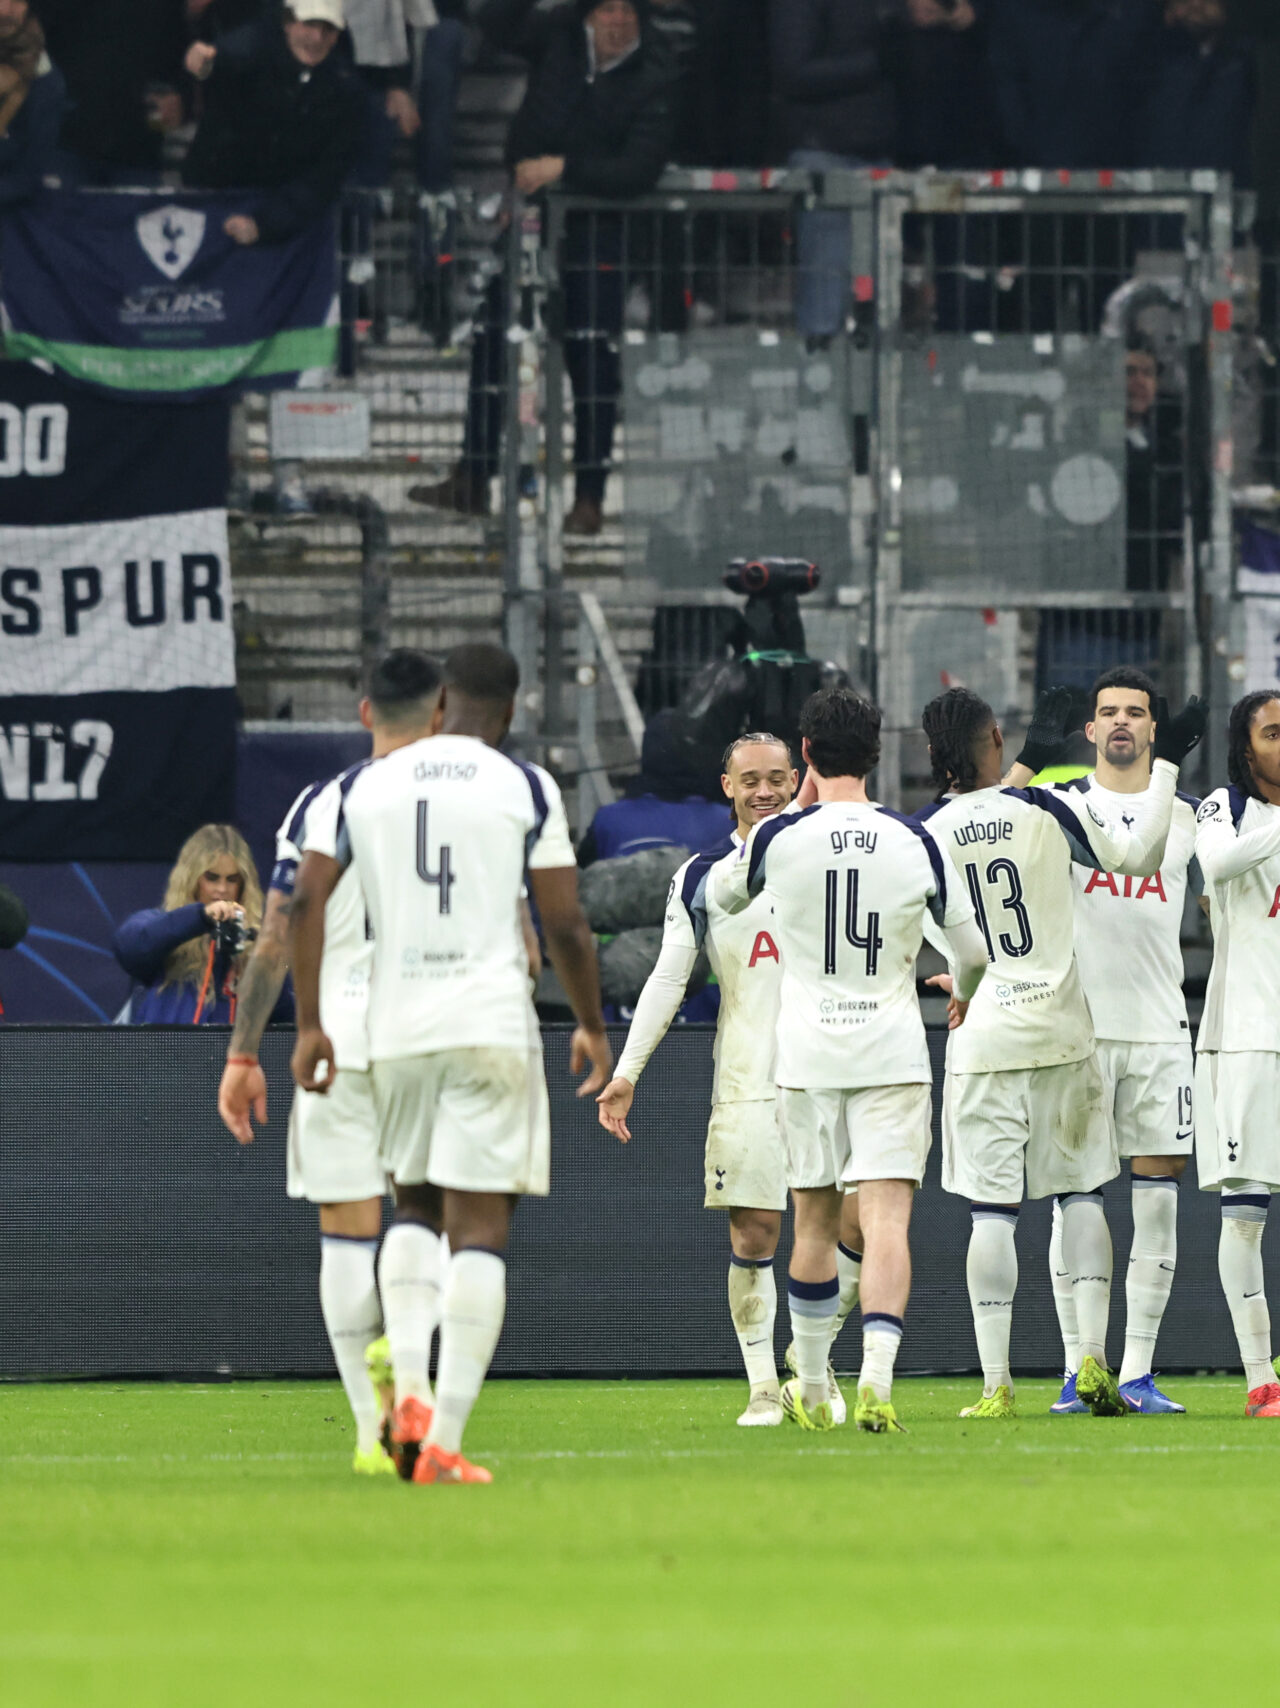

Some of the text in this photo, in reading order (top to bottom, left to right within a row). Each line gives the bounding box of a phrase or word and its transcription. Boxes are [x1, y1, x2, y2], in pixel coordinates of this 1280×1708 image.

[1, 553, 224, 636] SPUR
[414, 761, 478, 782] danso
[416, 800, 455, 916] 4
[831, 830, 878, 854] gray
[953, 817, 1013, 846] udogie
[965, 857, 1034, 964] 13
[1084, 869, 1167, 902] AIA
[824, 868, 883, 976] 14
